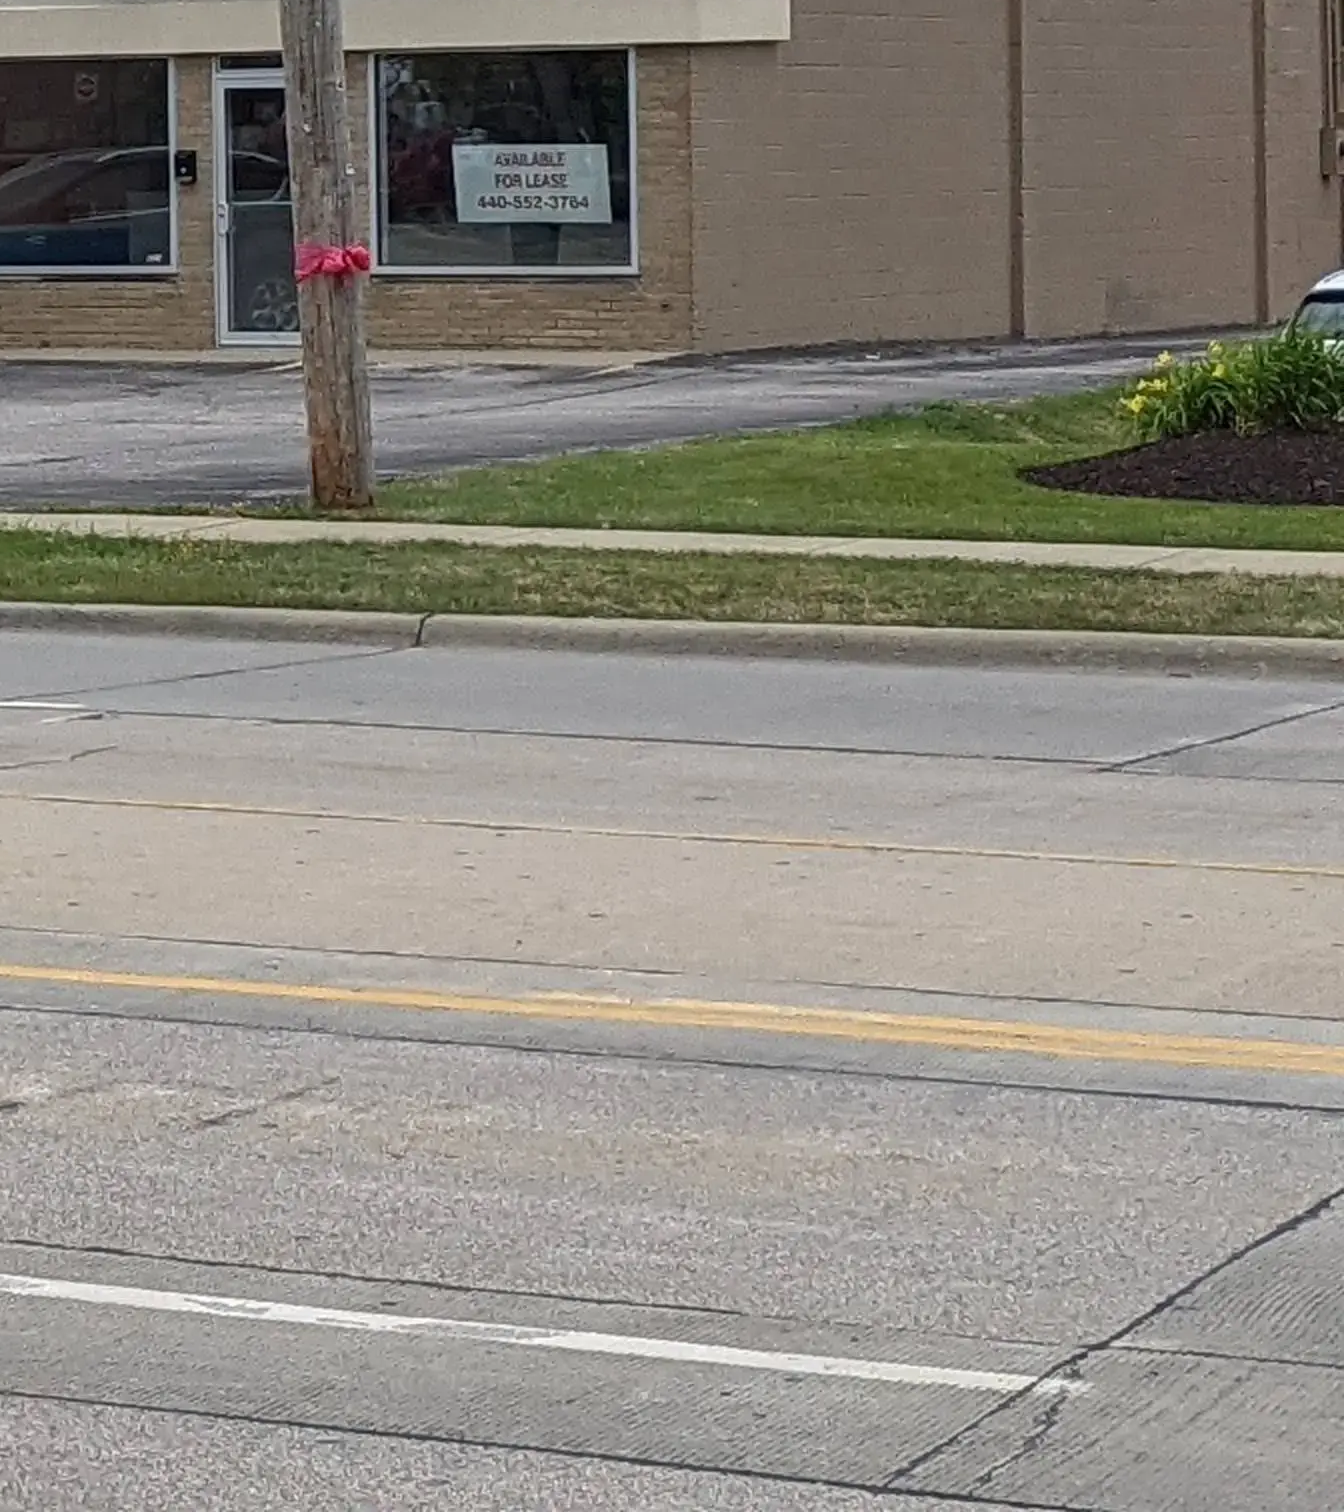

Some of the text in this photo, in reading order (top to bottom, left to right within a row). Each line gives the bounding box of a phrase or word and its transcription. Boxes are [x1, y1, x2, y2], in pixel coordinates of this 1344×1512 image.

[494, 152, 567, 166] AVAILABLE
[494, 173, 569, 189] FOR LEASE
